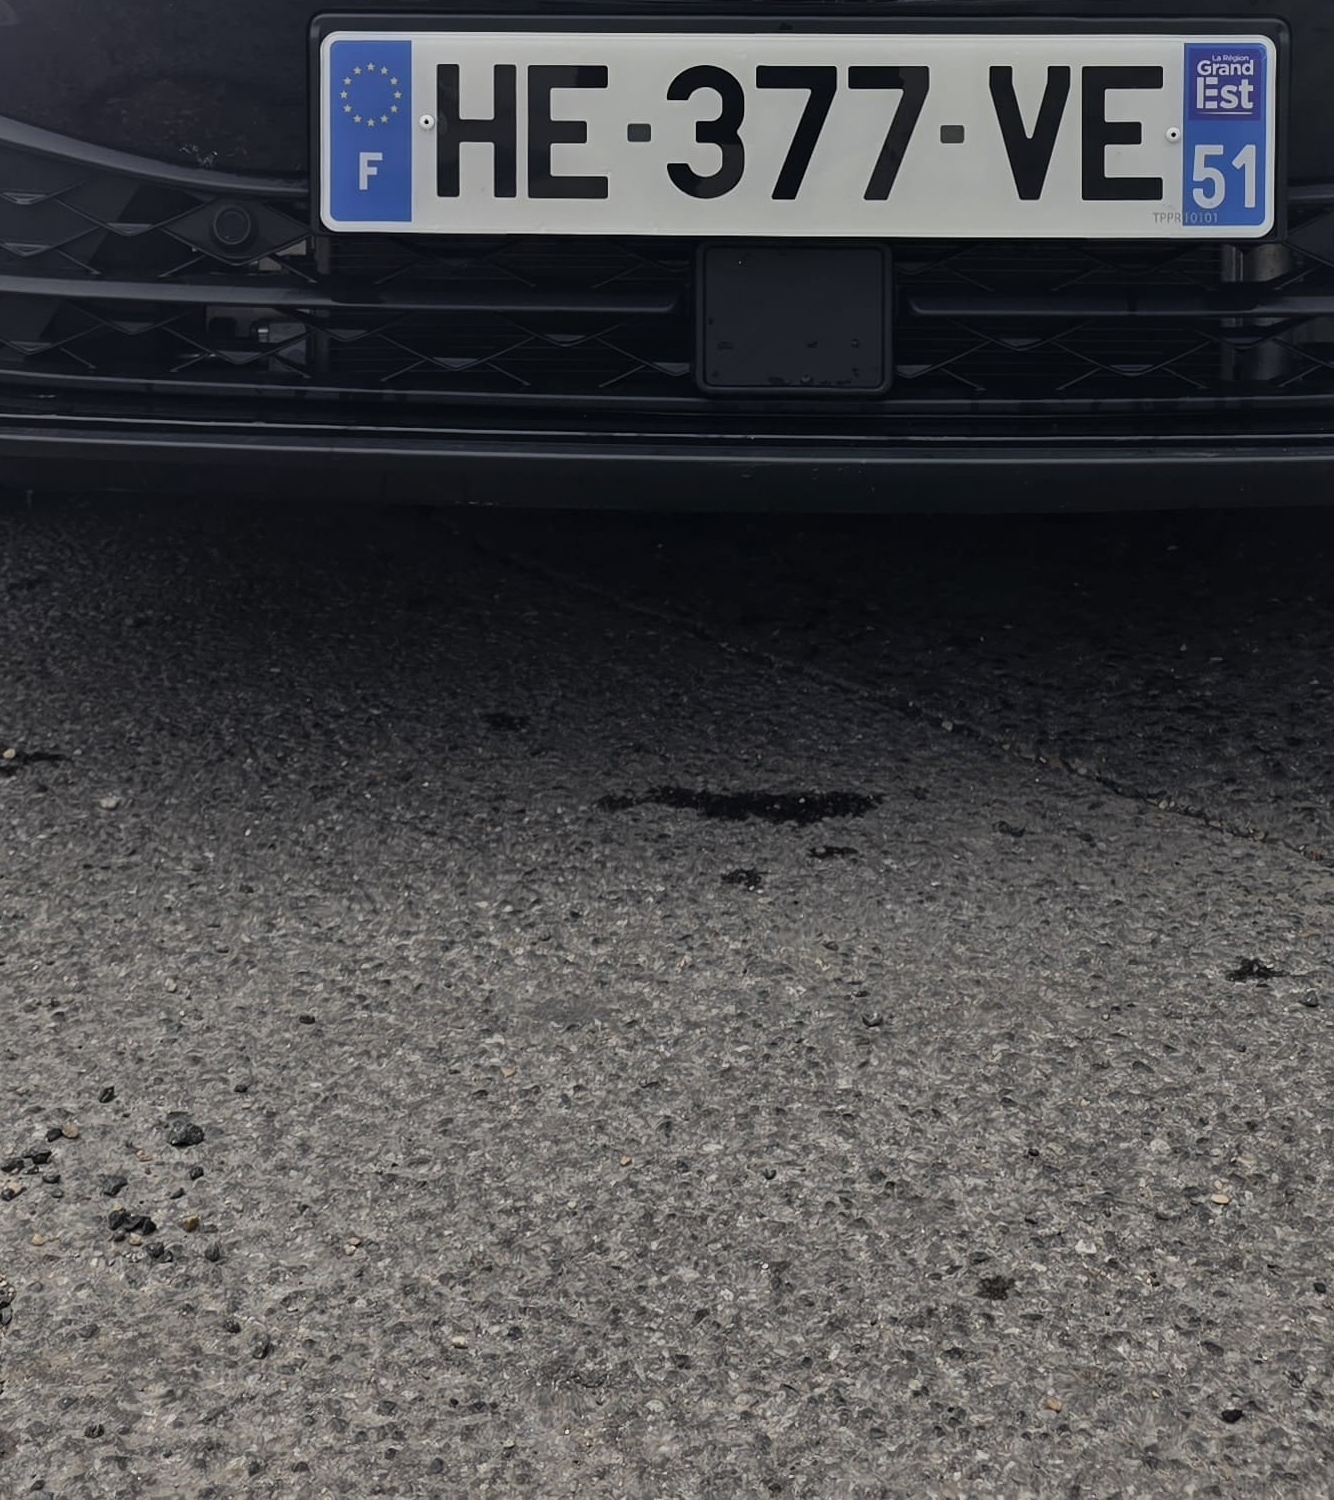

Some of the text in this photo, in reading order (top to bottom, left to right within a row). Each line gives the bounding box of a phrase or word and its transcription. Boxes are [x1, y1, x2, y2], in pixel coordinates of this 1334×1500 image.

[1196, 59, 1255, 76] Grand
[1196, 76, 1255, 109] Est
[435, 63, 1164, 201] HE-377-VE
[359, 151, 384, 191] F
[1192, 144, 1257, 210] 51
